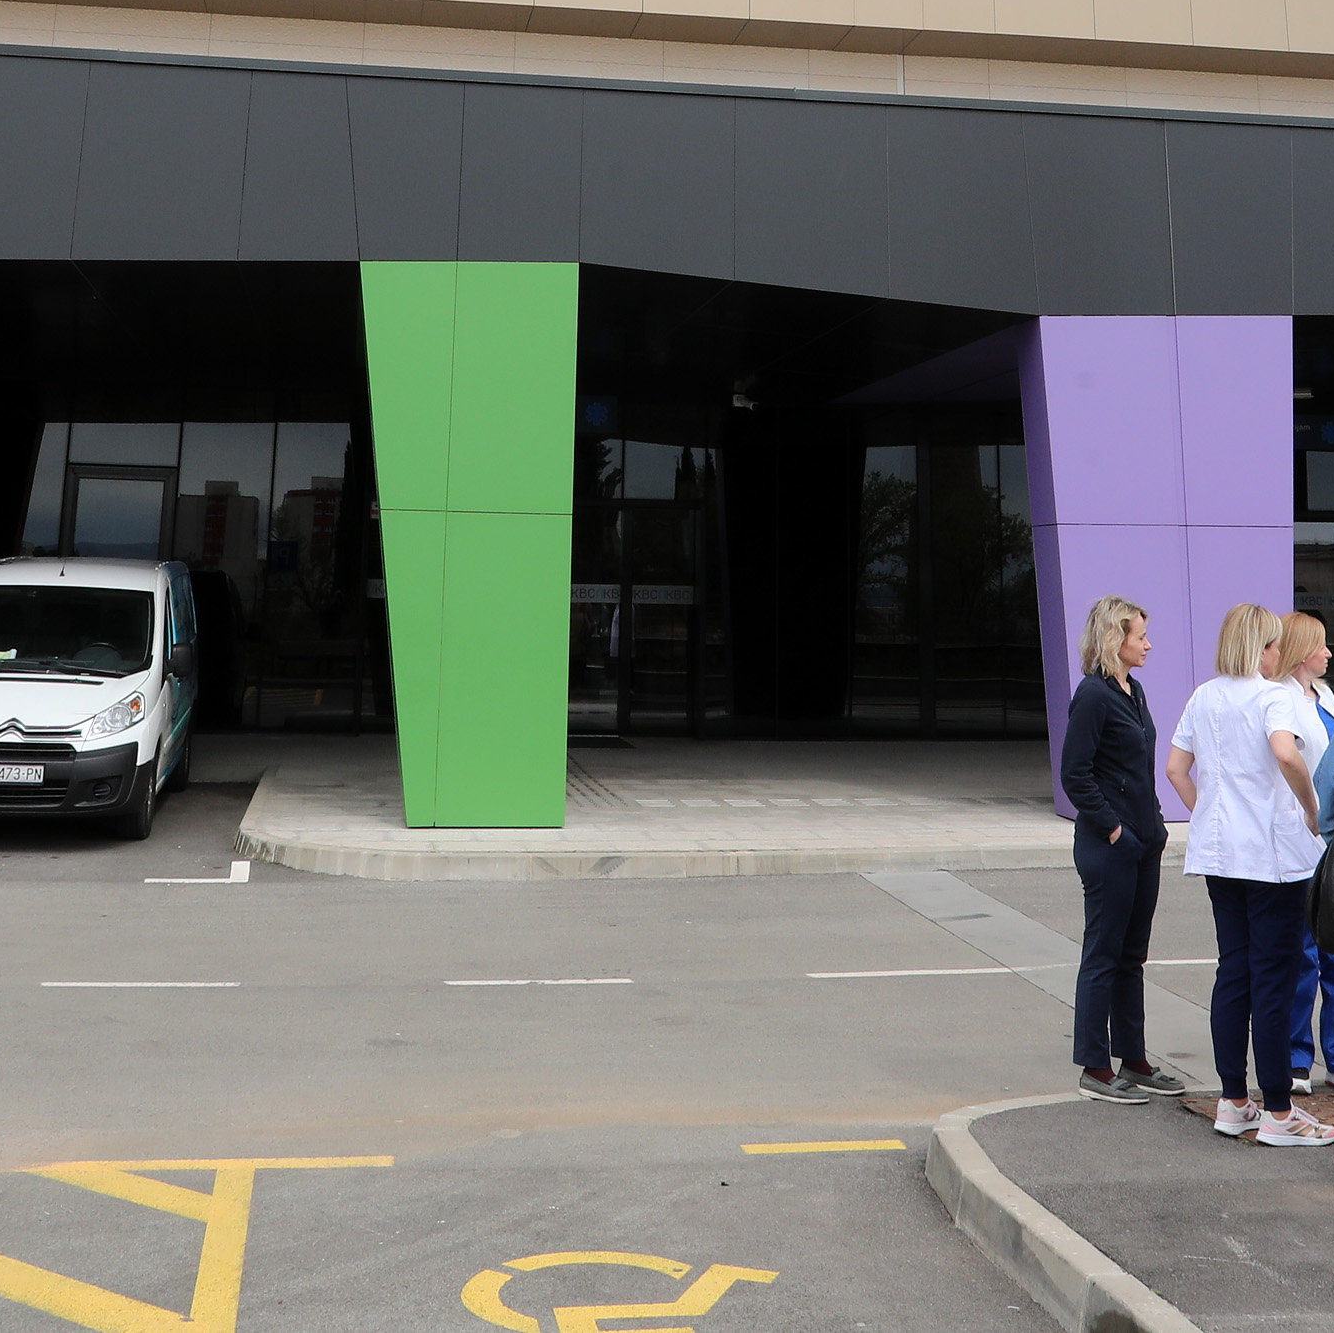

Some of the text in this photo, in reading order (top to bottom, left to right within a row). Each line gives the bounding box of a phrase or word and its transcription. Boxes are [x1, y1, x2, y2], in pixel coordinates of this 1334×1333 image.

[572, 588, 620, 599] KBC KB
[633, 590, 658, 600] KBC
